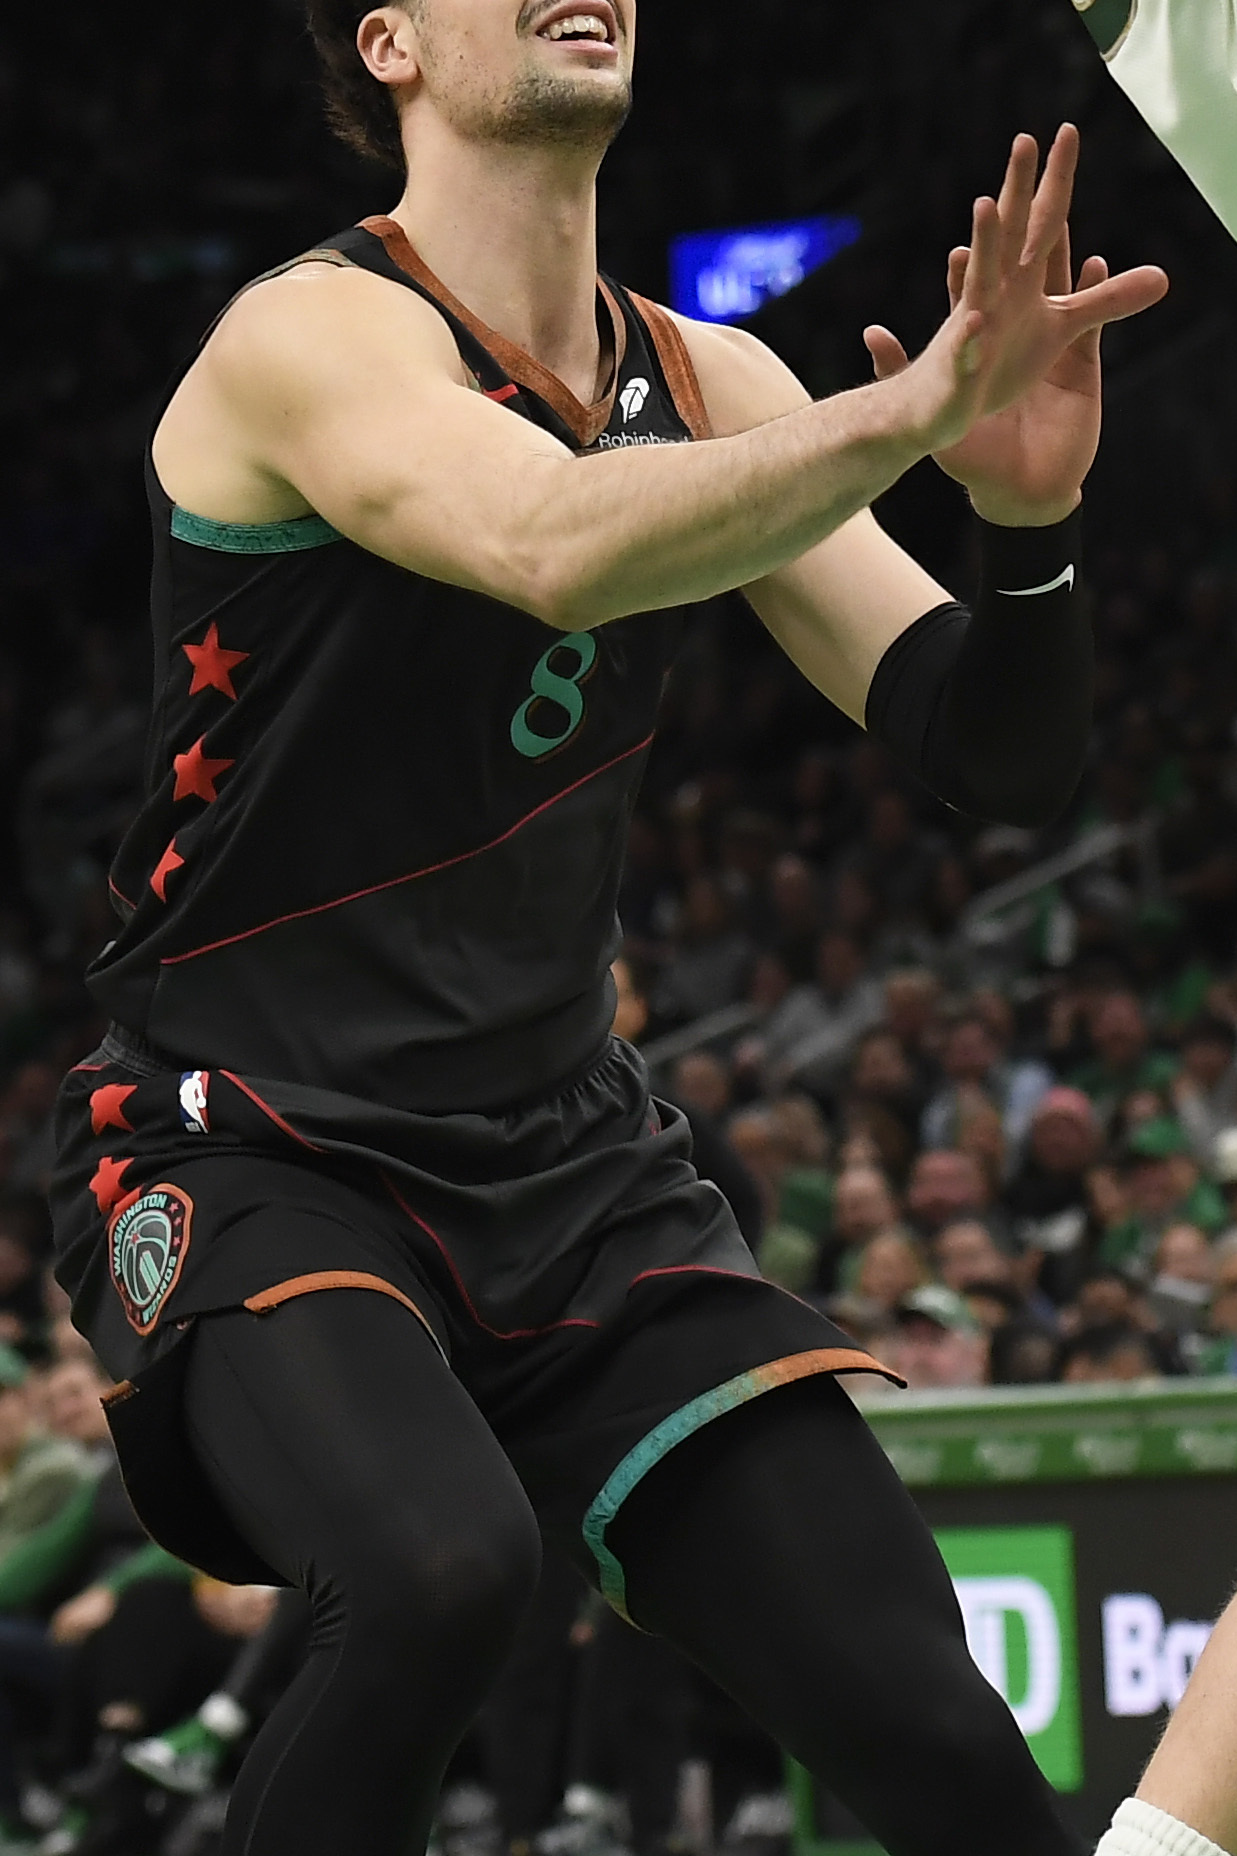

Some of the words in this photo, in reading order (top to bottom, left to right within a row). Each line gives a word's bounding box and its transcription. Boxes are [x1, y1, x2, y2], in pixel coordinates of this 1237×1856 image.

[510, 631, 600, 763] 8
[113, 1194, 168, 1277] WASHINGTON
[1101, 1593, 1216, 1717] Ba
